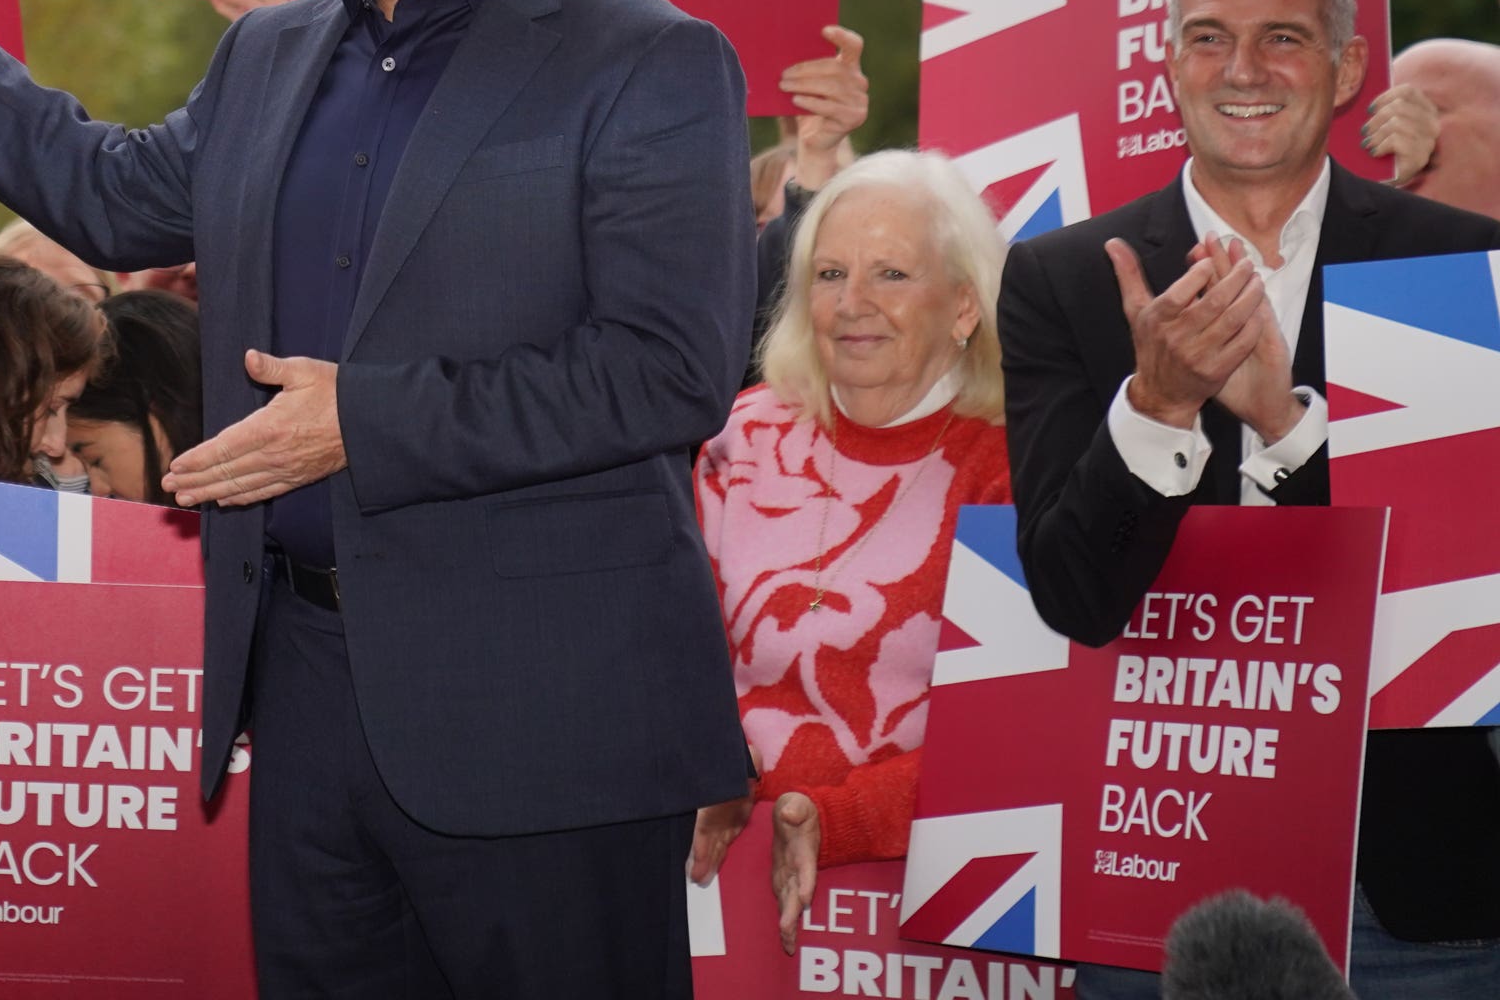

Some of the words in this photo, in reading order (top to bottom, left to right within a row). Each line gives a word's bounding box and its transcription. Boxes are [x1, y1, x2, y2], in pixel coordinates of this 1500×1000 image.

[1136, 129, 1187, 153] Labo
[1230, 595, 1314, 645] GET
[103, 665, 203, 713] GET
[1113, 655, 1342, 715] BRITAIN'S
[1105, 719, 1279, 778] FUTURE
[1099, 784, 1212, 841] BACK
[1111, 852, 1180, 882] Labour
[802, 888, 901, 936] LET'
[799, 946, 1076, 1000] BRITAIN'
